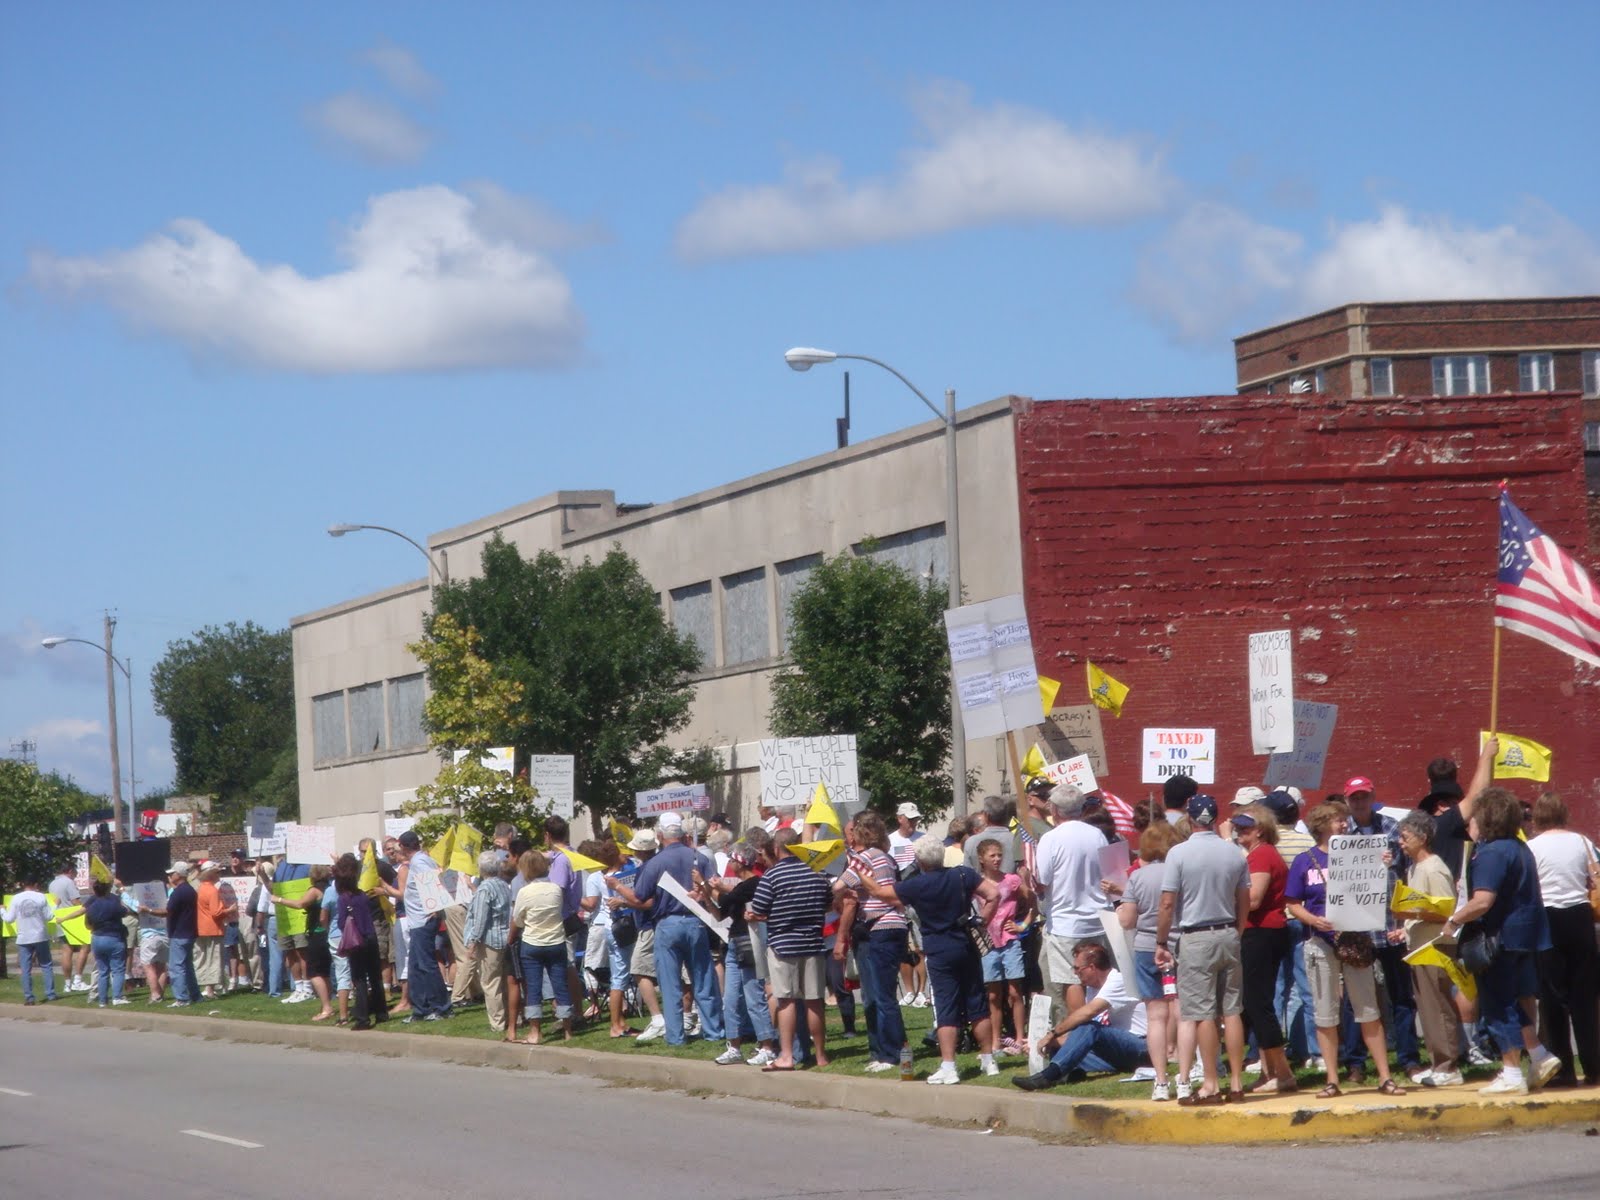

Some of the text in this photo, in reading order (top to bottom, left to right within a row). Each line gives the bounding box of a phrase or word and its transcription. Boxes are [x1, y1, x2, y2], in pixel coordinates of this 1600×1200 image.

[1007, 624, 1028, 635] Hope
[1258, 655, 1278, 678] YOU
[1008, 670, 1030, 681] Hope
[1260, 705, 1276, 731] US
[760, 739, 788, 757] WE
[803, 735, 856, 754] PEOPLE
[1157, 733, 1204, 745] TAXED
[760, 751, 846, 770] WILL BE
[1168, 747, 1188, 760] TO
[775, 766, 840, 788] SILENT
[1157, 764, 1196, 777] DEBT
[764, 786, 796, 803] NO
[650, 798, 693, 812] AMERICA
[1331, 836, 1387, 850] CONGRESS
[1331, 854, 1376, 866] WE ARE
[1329, 867, 1385, 881] WATCHING
[1349, 882, 1370, 893] AND
[1328, 892, 1387, 906] WE VOTE
